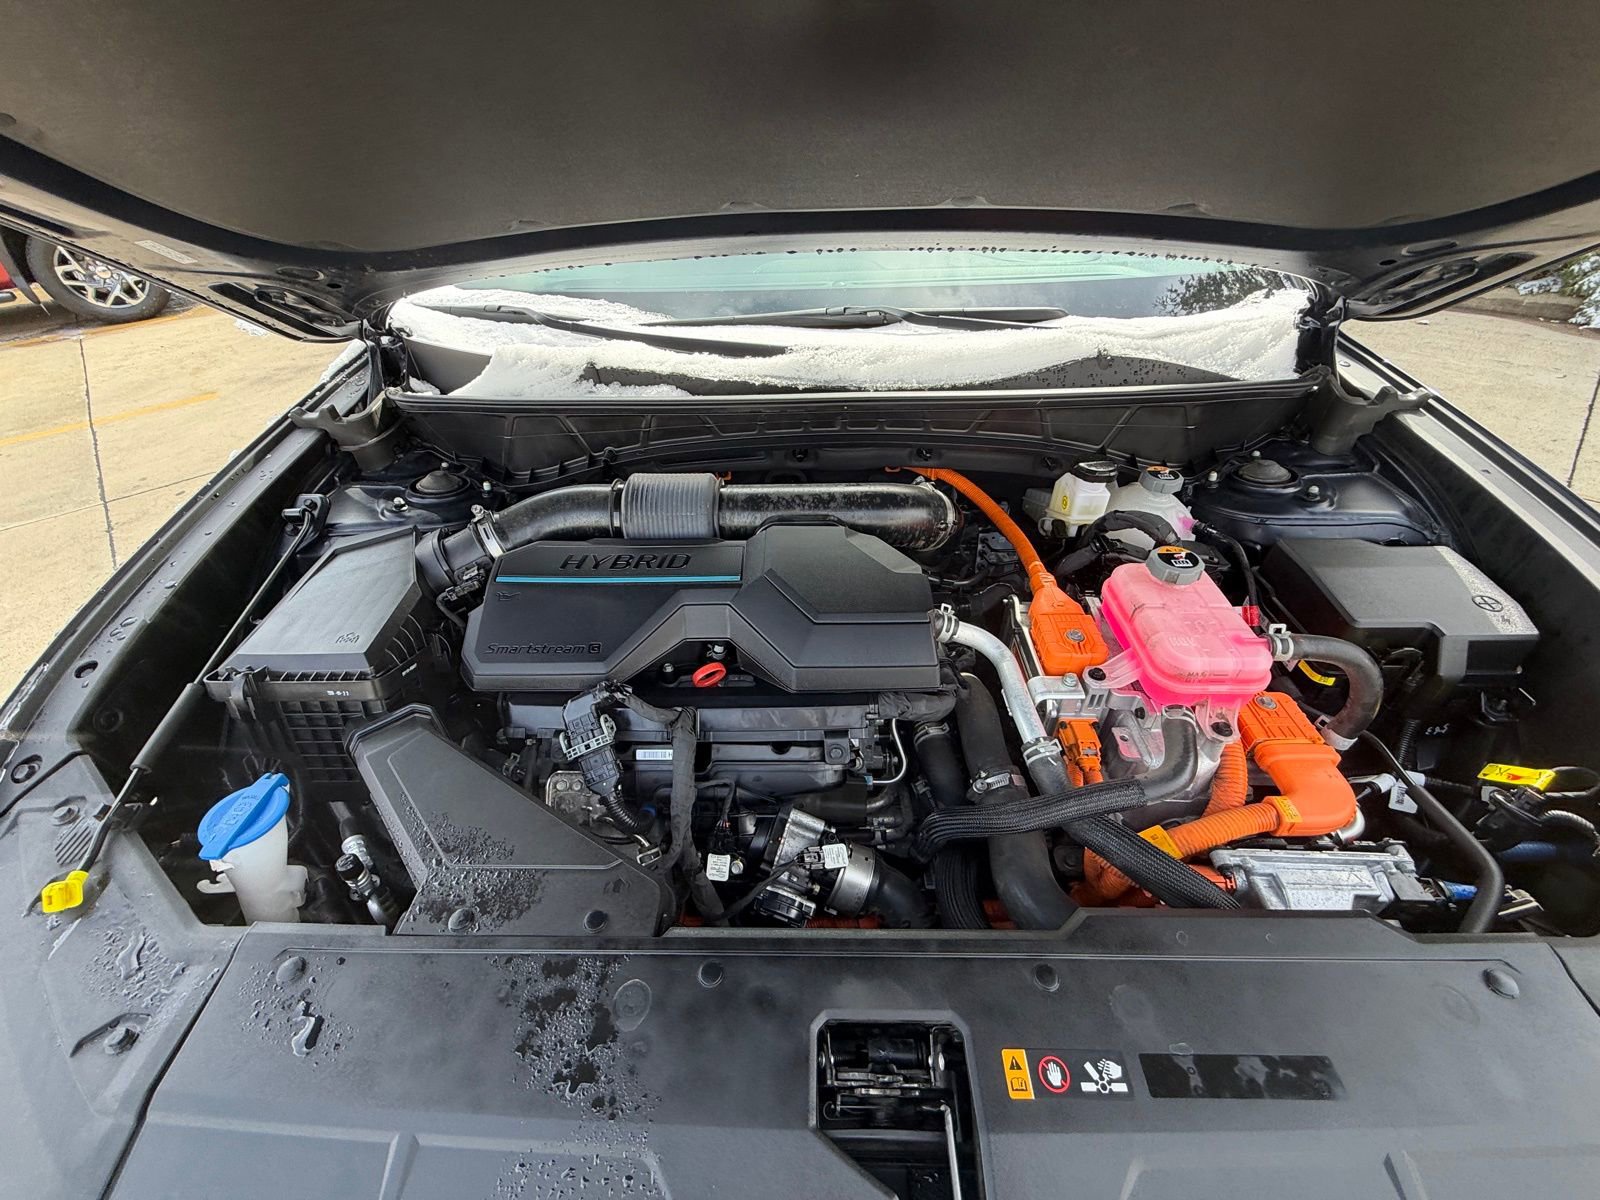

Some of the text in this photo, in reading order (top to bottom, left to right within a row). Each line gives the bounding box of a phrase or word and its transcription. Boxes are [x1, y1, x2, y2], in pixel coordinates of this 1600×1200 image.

[559, 553, 692, 571] HYBRID
[483, 641, 602, 655] Smartstream G
